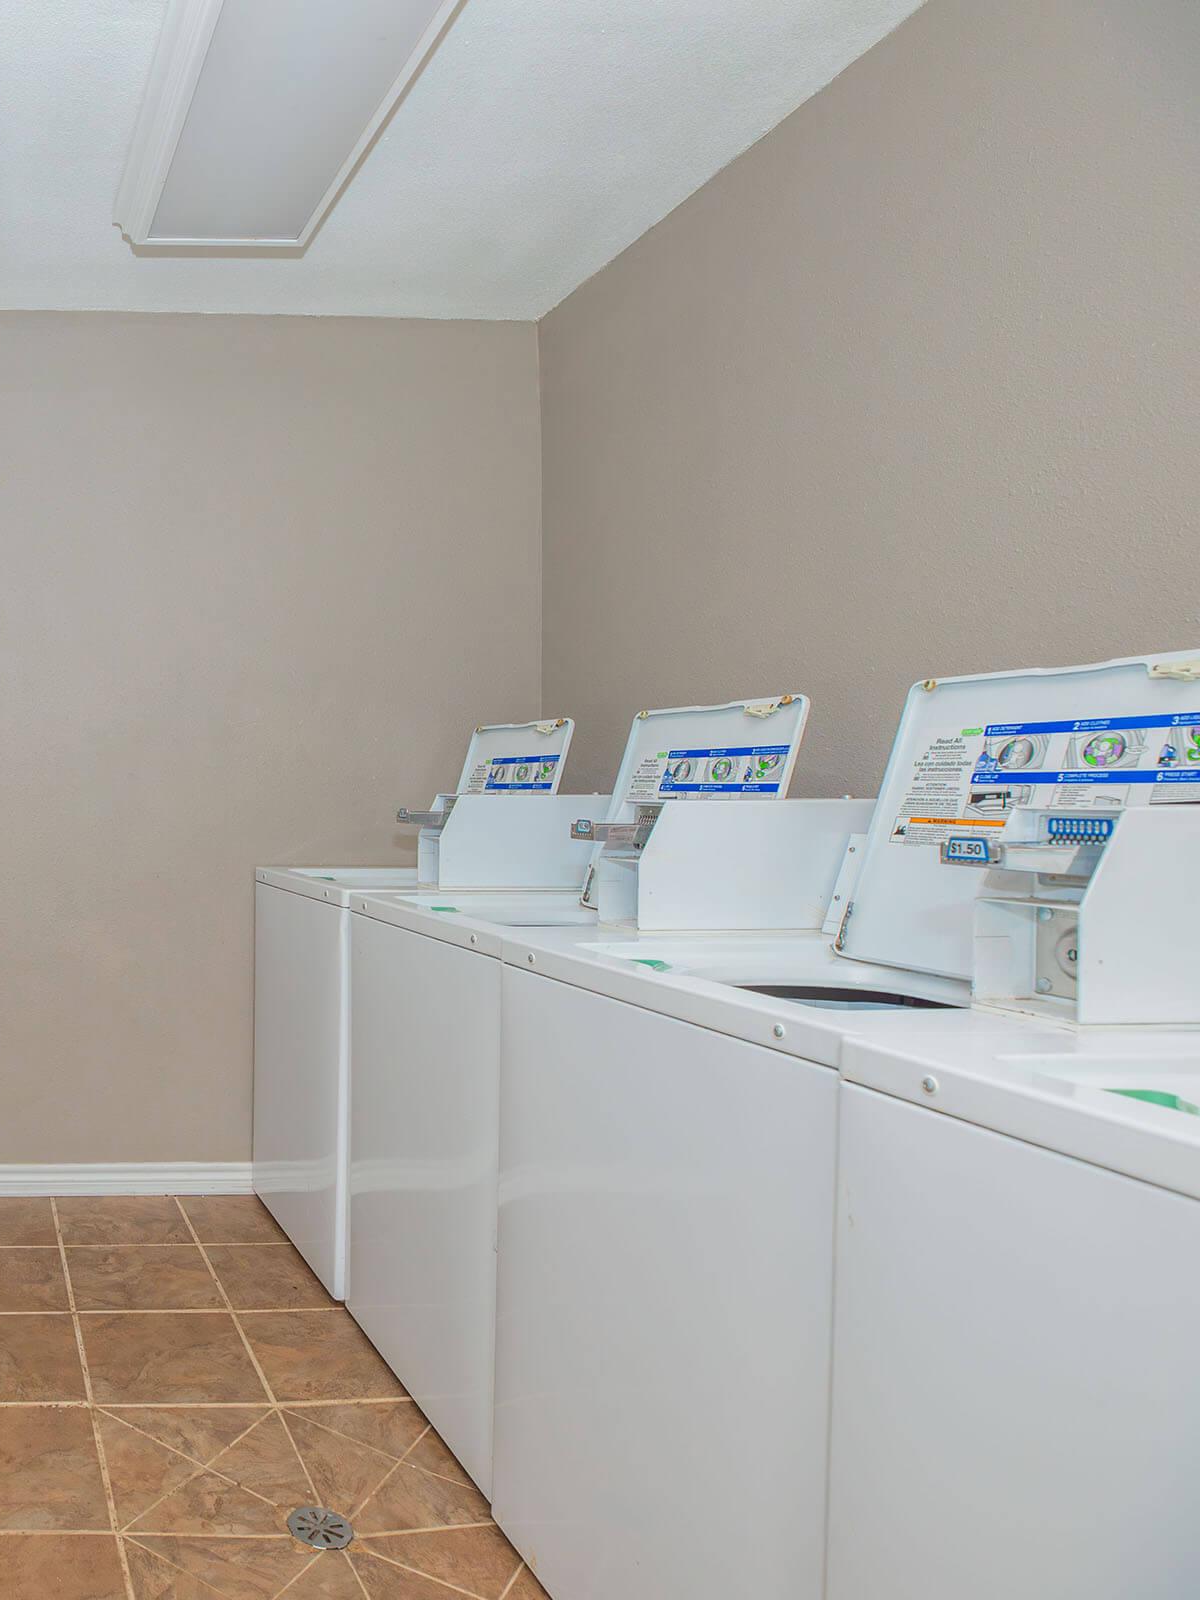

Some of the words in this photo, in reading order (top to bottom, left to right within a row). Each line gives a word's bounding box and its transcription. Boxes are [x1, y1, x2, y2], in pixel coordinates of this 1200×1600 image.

[1171, 716, 1180, 725] 3
[1073, 722, 1080, 731] 2
[1057, 773, 1065, 782] 5
[1156, 772, 1163, 781] 6
[951, 842, 981, 855] $1.50
